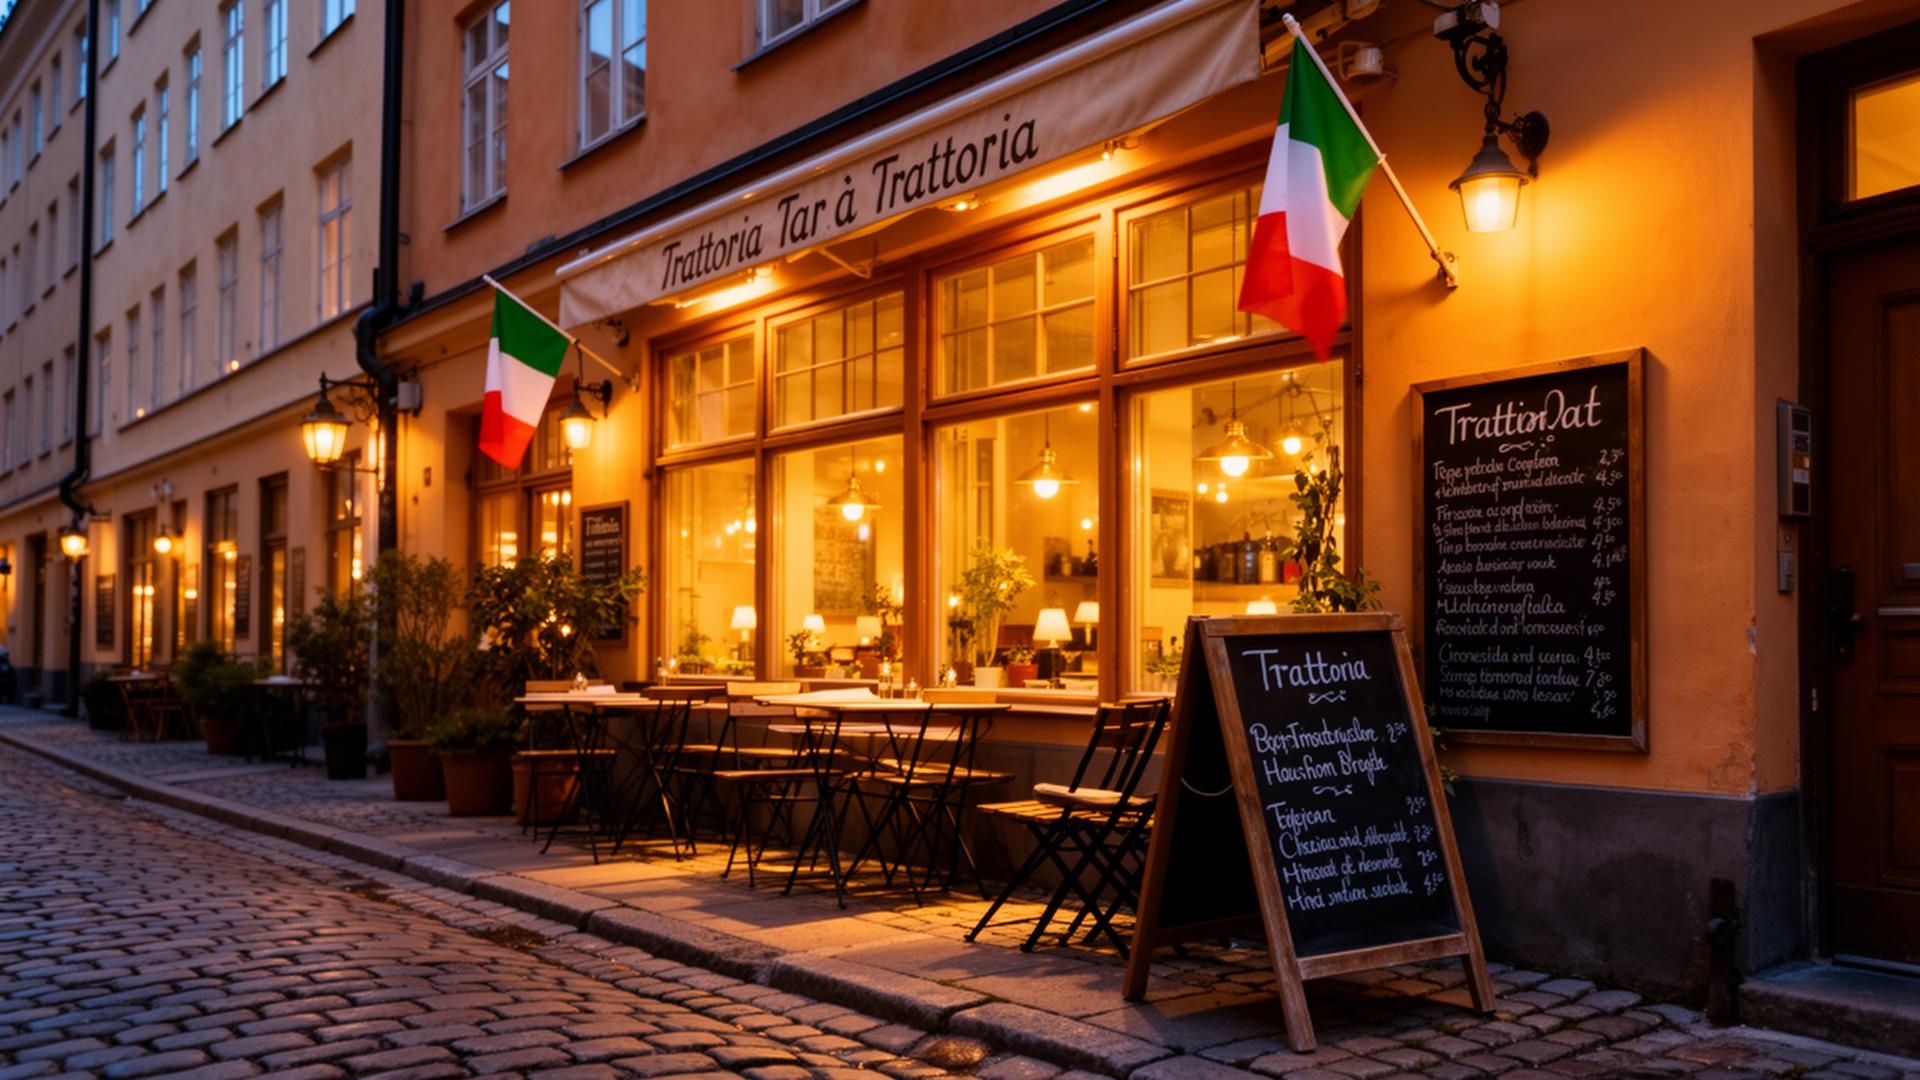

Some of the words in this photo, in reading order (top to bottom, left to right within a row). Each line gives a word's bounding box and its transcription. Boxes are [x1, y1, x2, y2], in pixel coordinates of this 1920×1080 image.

[661, 216, 763, 290] Trattoria
[872, 113, 1039, 214] Trattoria
[1241, 649, 1371, 691] Trattoria
